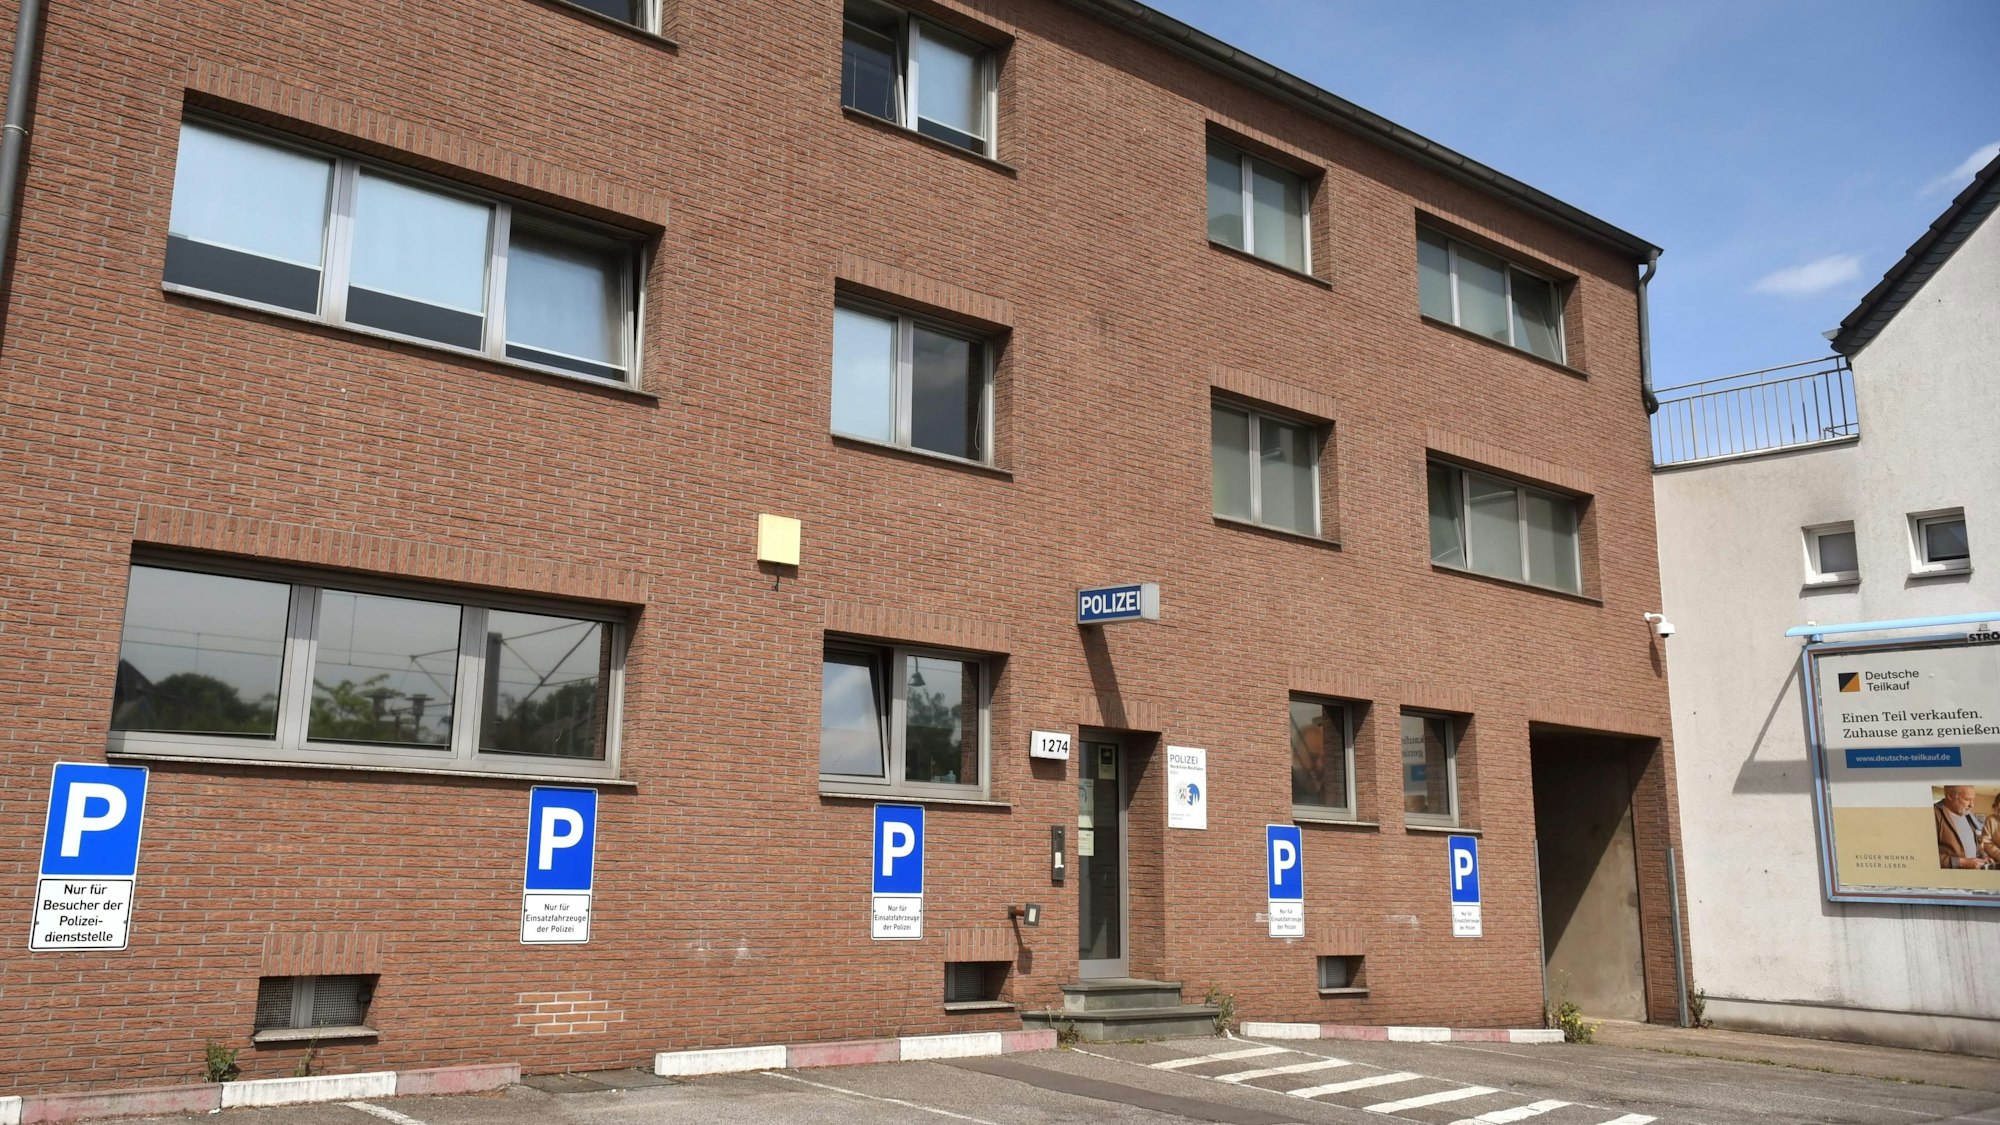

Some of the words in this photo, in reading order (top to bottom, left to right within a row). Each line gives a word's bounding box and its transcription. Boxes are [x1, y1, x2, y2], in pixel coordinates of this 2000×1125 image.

[1082, 591, 1140, 615] POLIZEI
[1865, 670, 1919, 680] Deutsche
[1866, 681, 1910, 691] Teilkauf
[1842, 713, 1878, 722] Einen
[1882, 711, 1906, 721] Teil
[1911, 709, 1982, 720] verkaufen.
[1844, 727, 1897, 738] Zuhause
[1902, 729, 1933, 738] ganz
[1042, 738, 1068, 754] 1274
[1170, 754, 1198, 764] POLIZEI
[1856, 754, 1950, 762] www.deutsche-teilkauf.de
[60, 782, 127, 857] P
[539, 807, 584, 870] P
[882, 821, 915, 876] P
[1273, 840, 1296, 885] P
[1454, 849, 1473, 890] P
[64, 884, 87, 894] Nur
[90, 884, 107, 894] für
[43, 900, 100, 910] Besucher
[103, 900, 123, 910] der
[559, 903, 570, 911] für
[60, 916, 103, 926] Polizei-
[526, 915, 586, 923] Einsatzfahrzeuge
[875, 914, 919, 922] Einsatzfahrzeuge
[537, 925, 548, 933] der
[551, 925, 574, 933] Polizei
[45, 932, 113, 942] dienststelle
